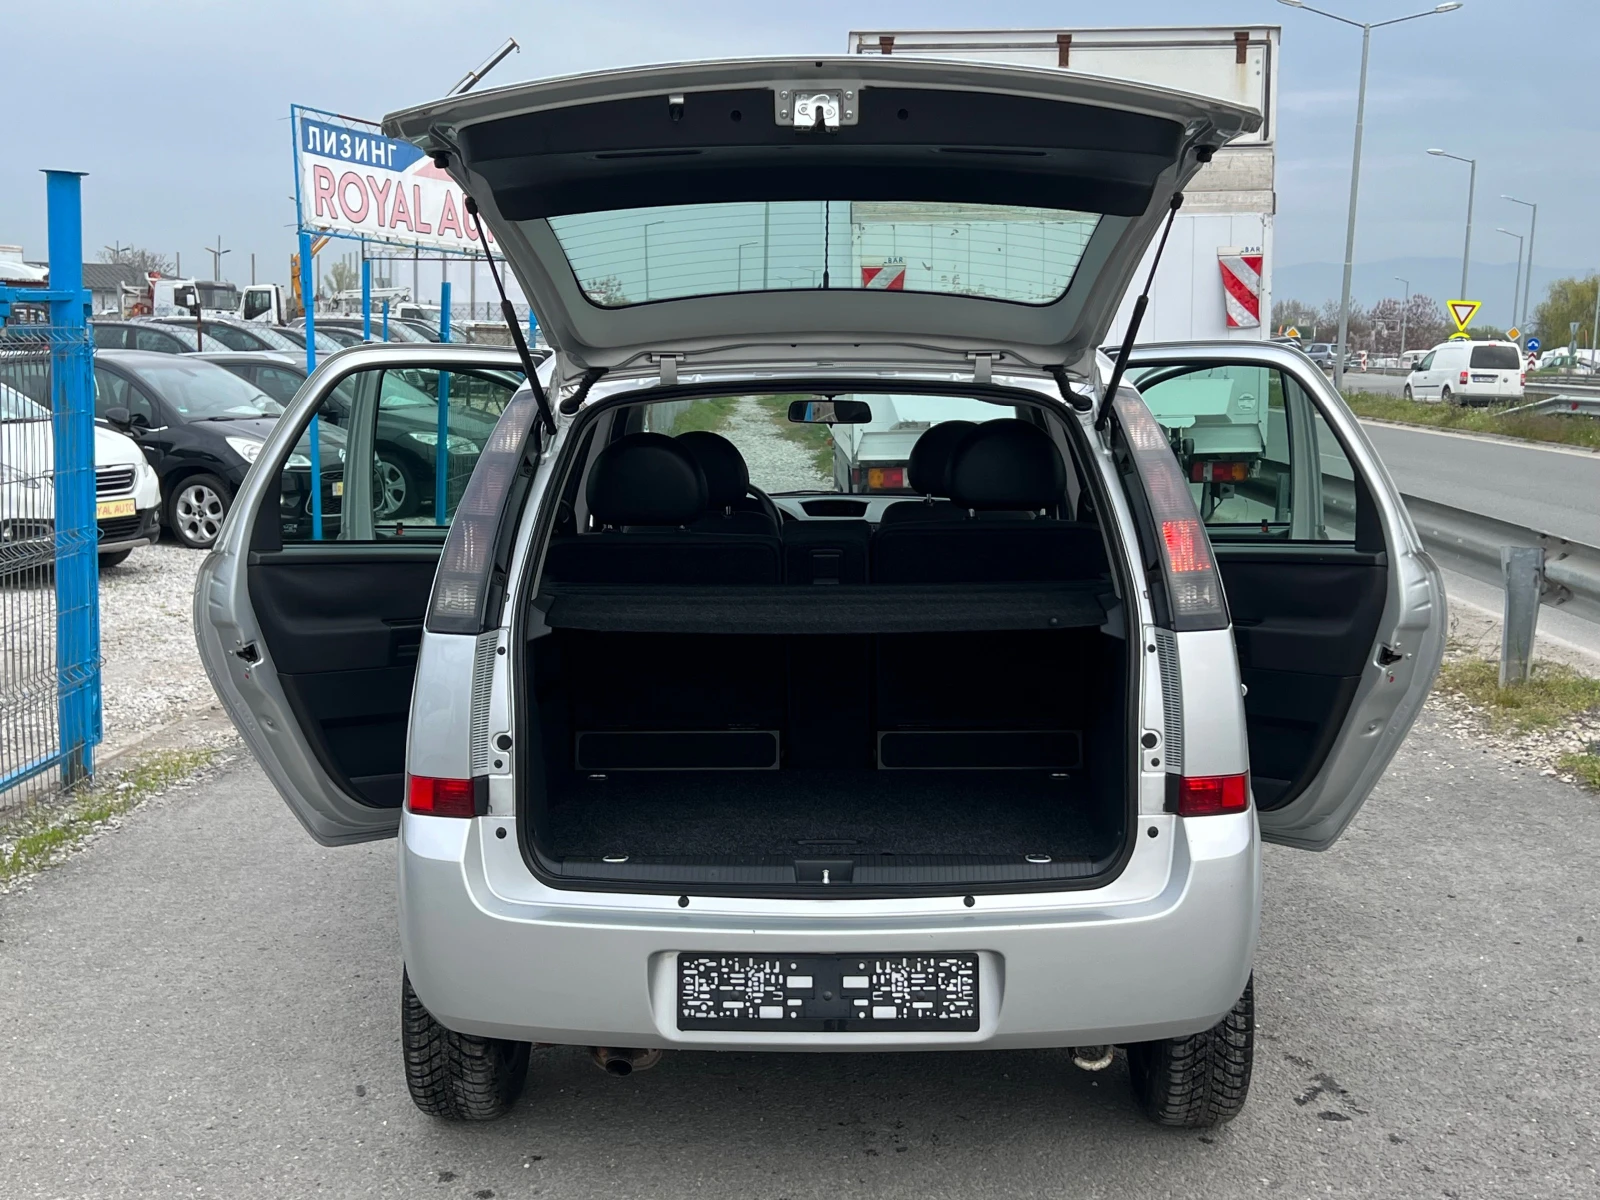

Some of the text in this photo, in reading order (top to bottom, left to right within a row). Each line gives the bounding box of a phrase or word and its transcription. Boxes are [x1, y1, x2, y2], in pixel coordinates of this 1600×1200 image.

[307, 126, 397, 167] ЛИЗИНГ
[313, 164, 494, 244] ROYAL AU
[97, 503, 134, 516] YAL AUTO
